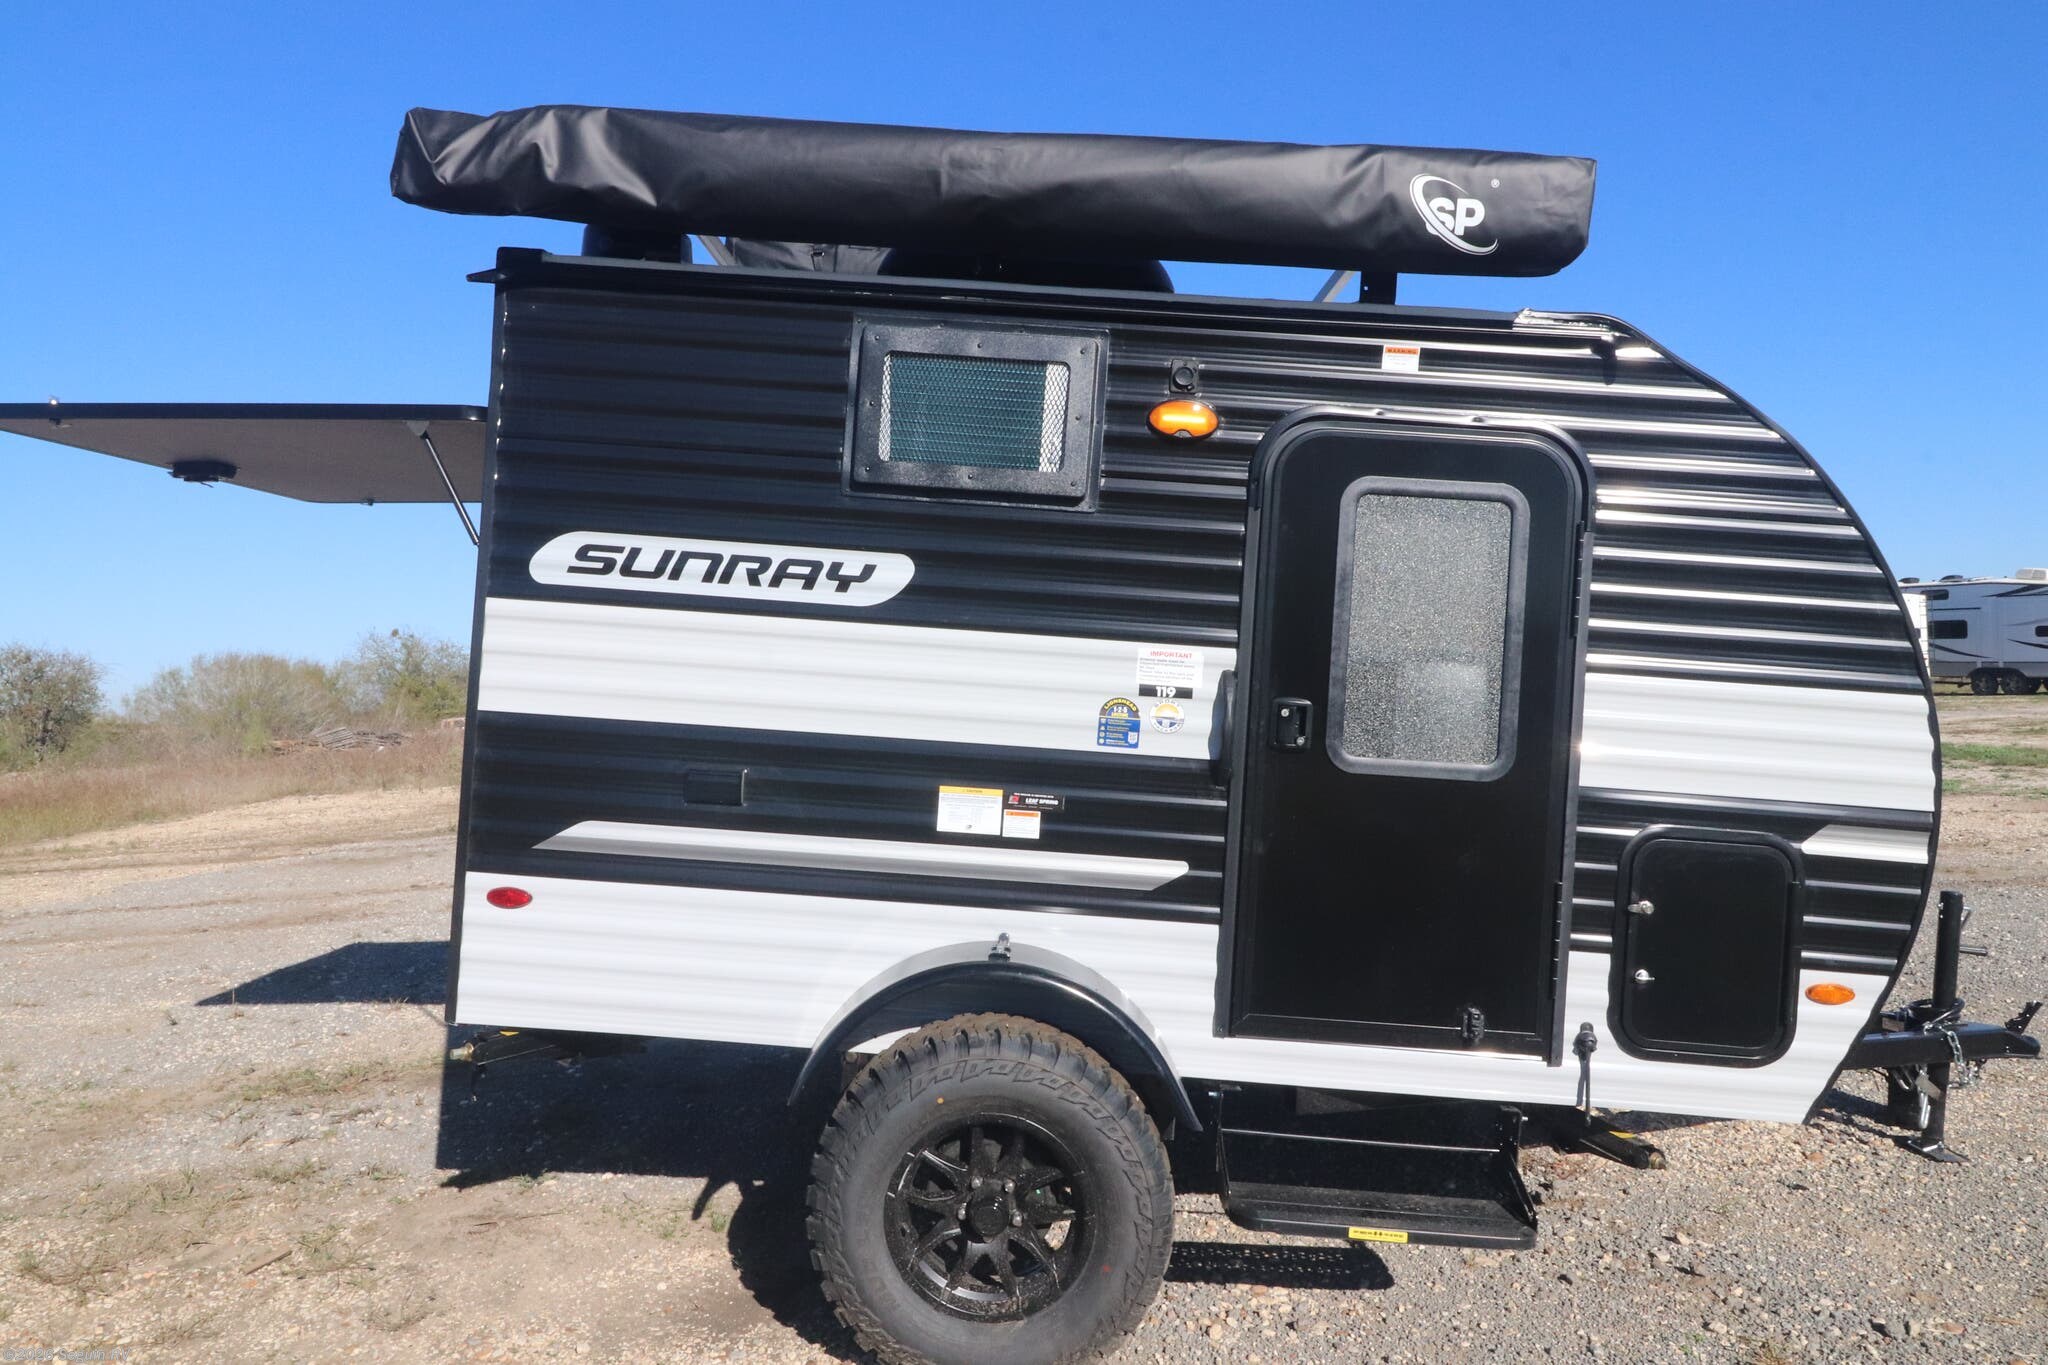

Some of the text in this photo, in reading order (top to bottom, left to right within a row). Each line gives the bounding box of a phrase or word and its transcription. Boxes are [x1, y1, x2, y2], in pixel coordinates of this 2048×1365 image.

[566, 543, 877, 593] SUNRAY
[1150, 650, 1193, 659] IMPORTANT
[1155, 686, 1177, 698] 119
